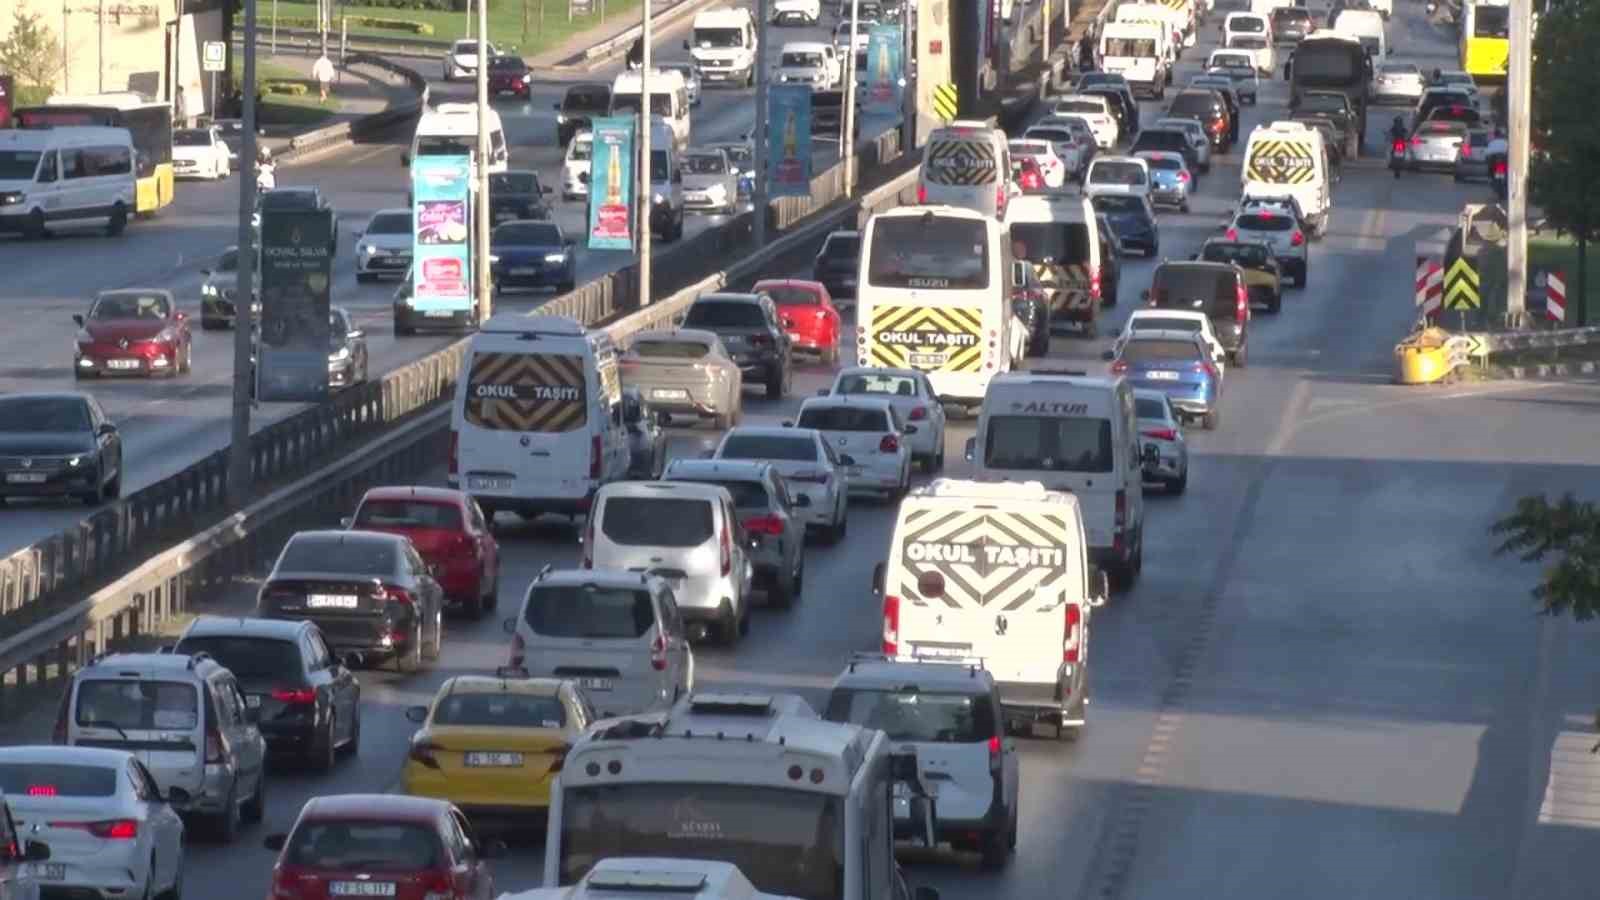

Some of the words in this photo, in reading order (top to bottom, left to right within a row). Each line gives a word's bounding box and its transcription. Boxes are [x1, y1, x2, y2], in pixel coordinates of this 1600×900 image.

[908, 279, 949, 287] ISUZU
[879, 331, 923, 344] OKUL
[476, 384, 518, 398] OKUL
[1023, 401, 1088, 415] ALTUR
[906, 542, 976, 563] OKUL
[983, 545, 1063, 569] TAŞITI
